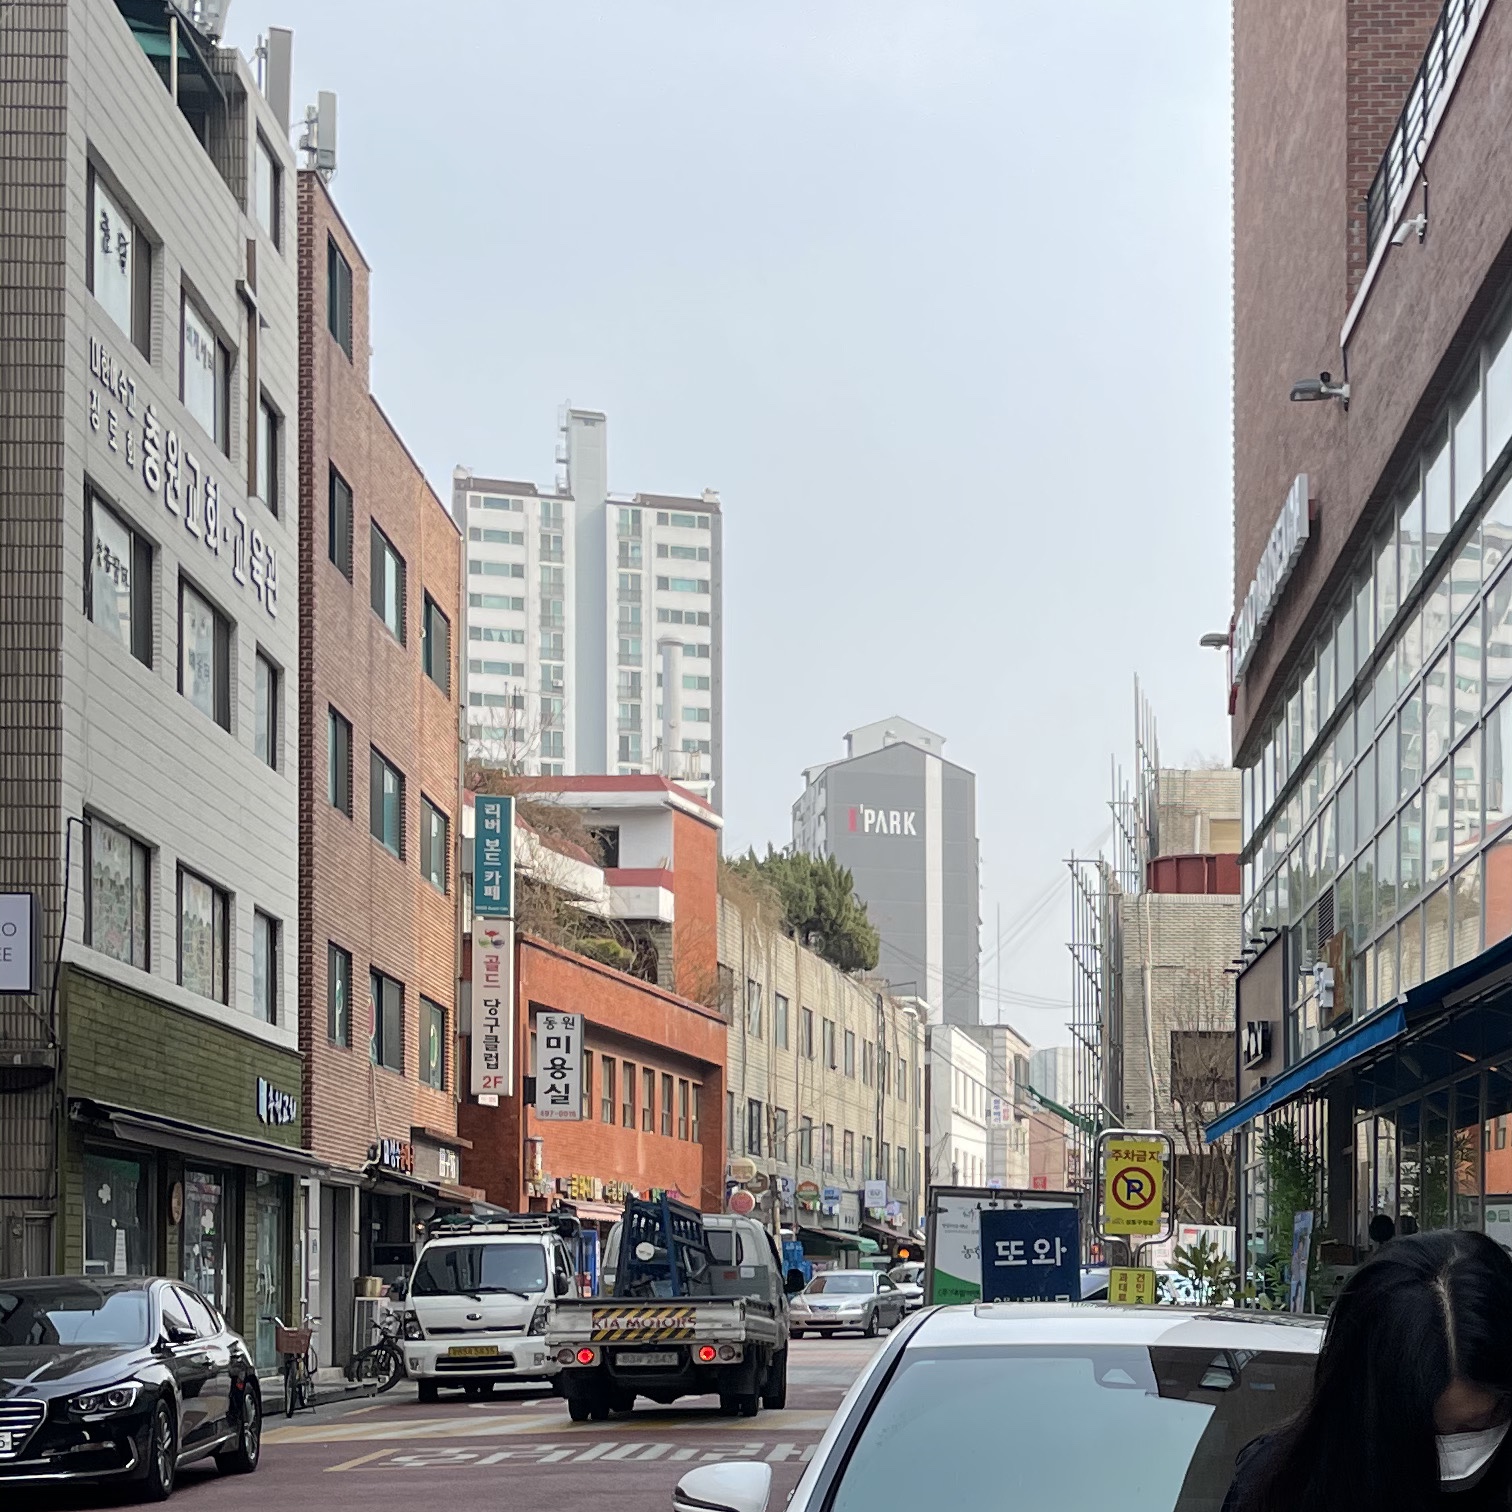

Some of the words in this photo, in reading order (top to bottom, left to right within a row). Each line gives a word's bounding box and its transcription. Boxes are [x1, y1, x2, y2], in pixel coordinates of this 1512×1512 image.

[484, 803, 501, 834] 리버
[483, 838, 502, 867] 보드
[483, 870, 502, 901] 카페
[483, 954, 501, 989] 골드
[483, 998, 502, 1070] 당구클럽
[542, 1015, 576, 1031] 동원
[482, 1075, 504, 1089] 2F
[542, 1035, 574, 1106] 미용실
[1111, 1149, 1161, 1163] 주차금지
[592, 1316, 620, 1330] KIA
[626, 1315, 697, 1330] MOTORS
